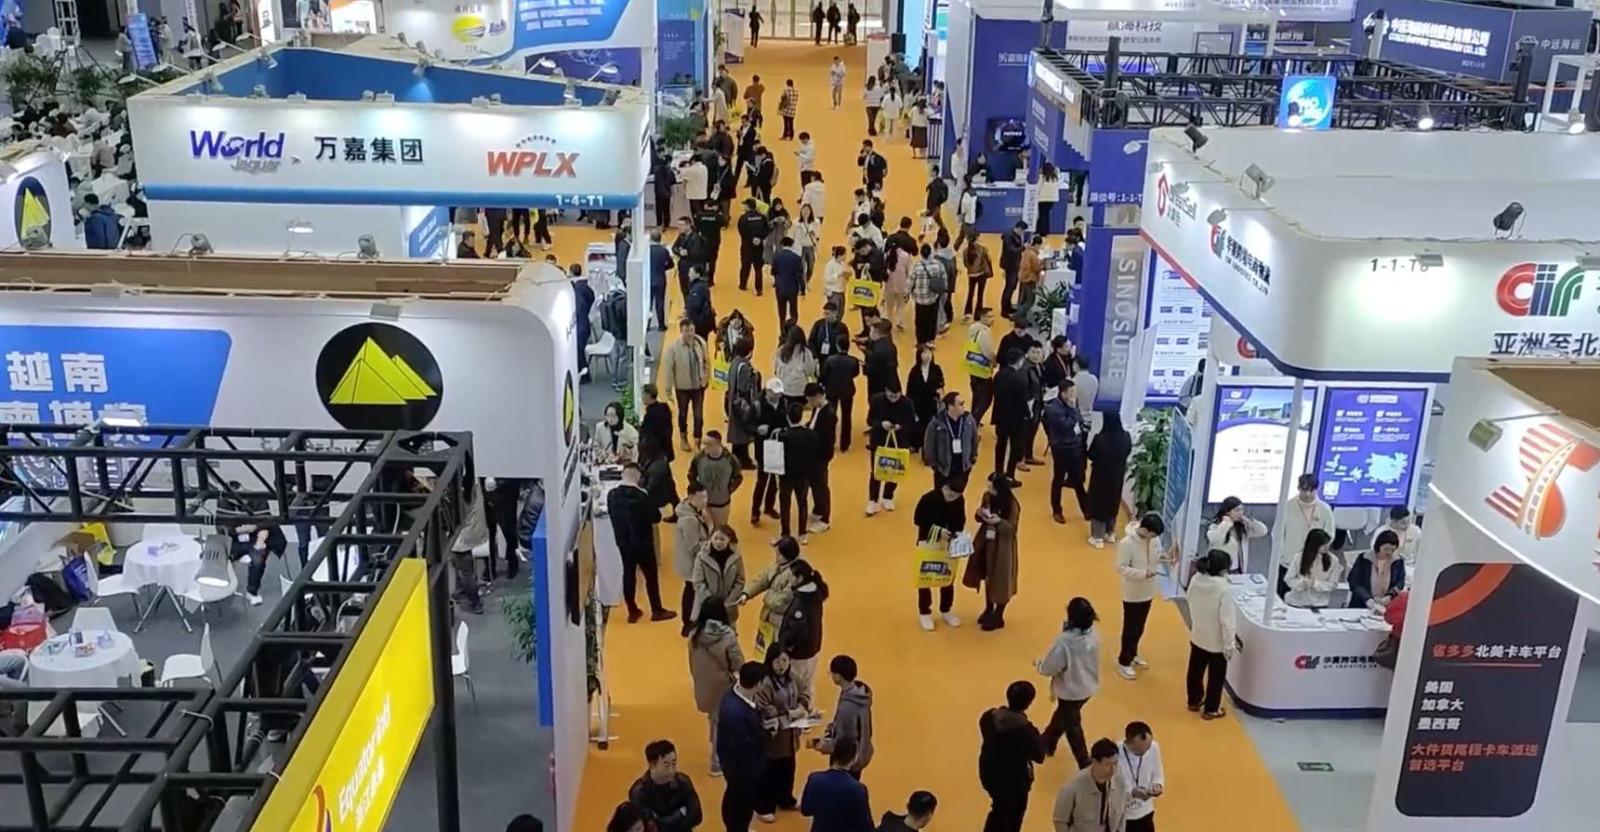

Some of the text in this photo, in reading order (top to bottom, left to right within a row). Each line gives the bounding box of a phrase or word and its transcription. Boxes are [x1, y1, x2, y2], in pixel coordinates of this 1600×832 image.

[190, 130, 285, 159] World
[314, 136, 423, 162] 万嘉集团
[231, 157, 281, 173] Jaguar
[487, 151, 580, 177] WPLX
[555, 194, 604, 206] 1-4-T1
[1108, 258, 1137, 379] SINOSURE
[5, 351, 108, 393] 越南
[1432, 644, 1562, 659] 省多多北美卡车平台
[1424, 681, 1454, 694] 美国
[1421, 698, 1465, 711] 加拿大
[1417, 717, 1461, 731] 墨西哥
